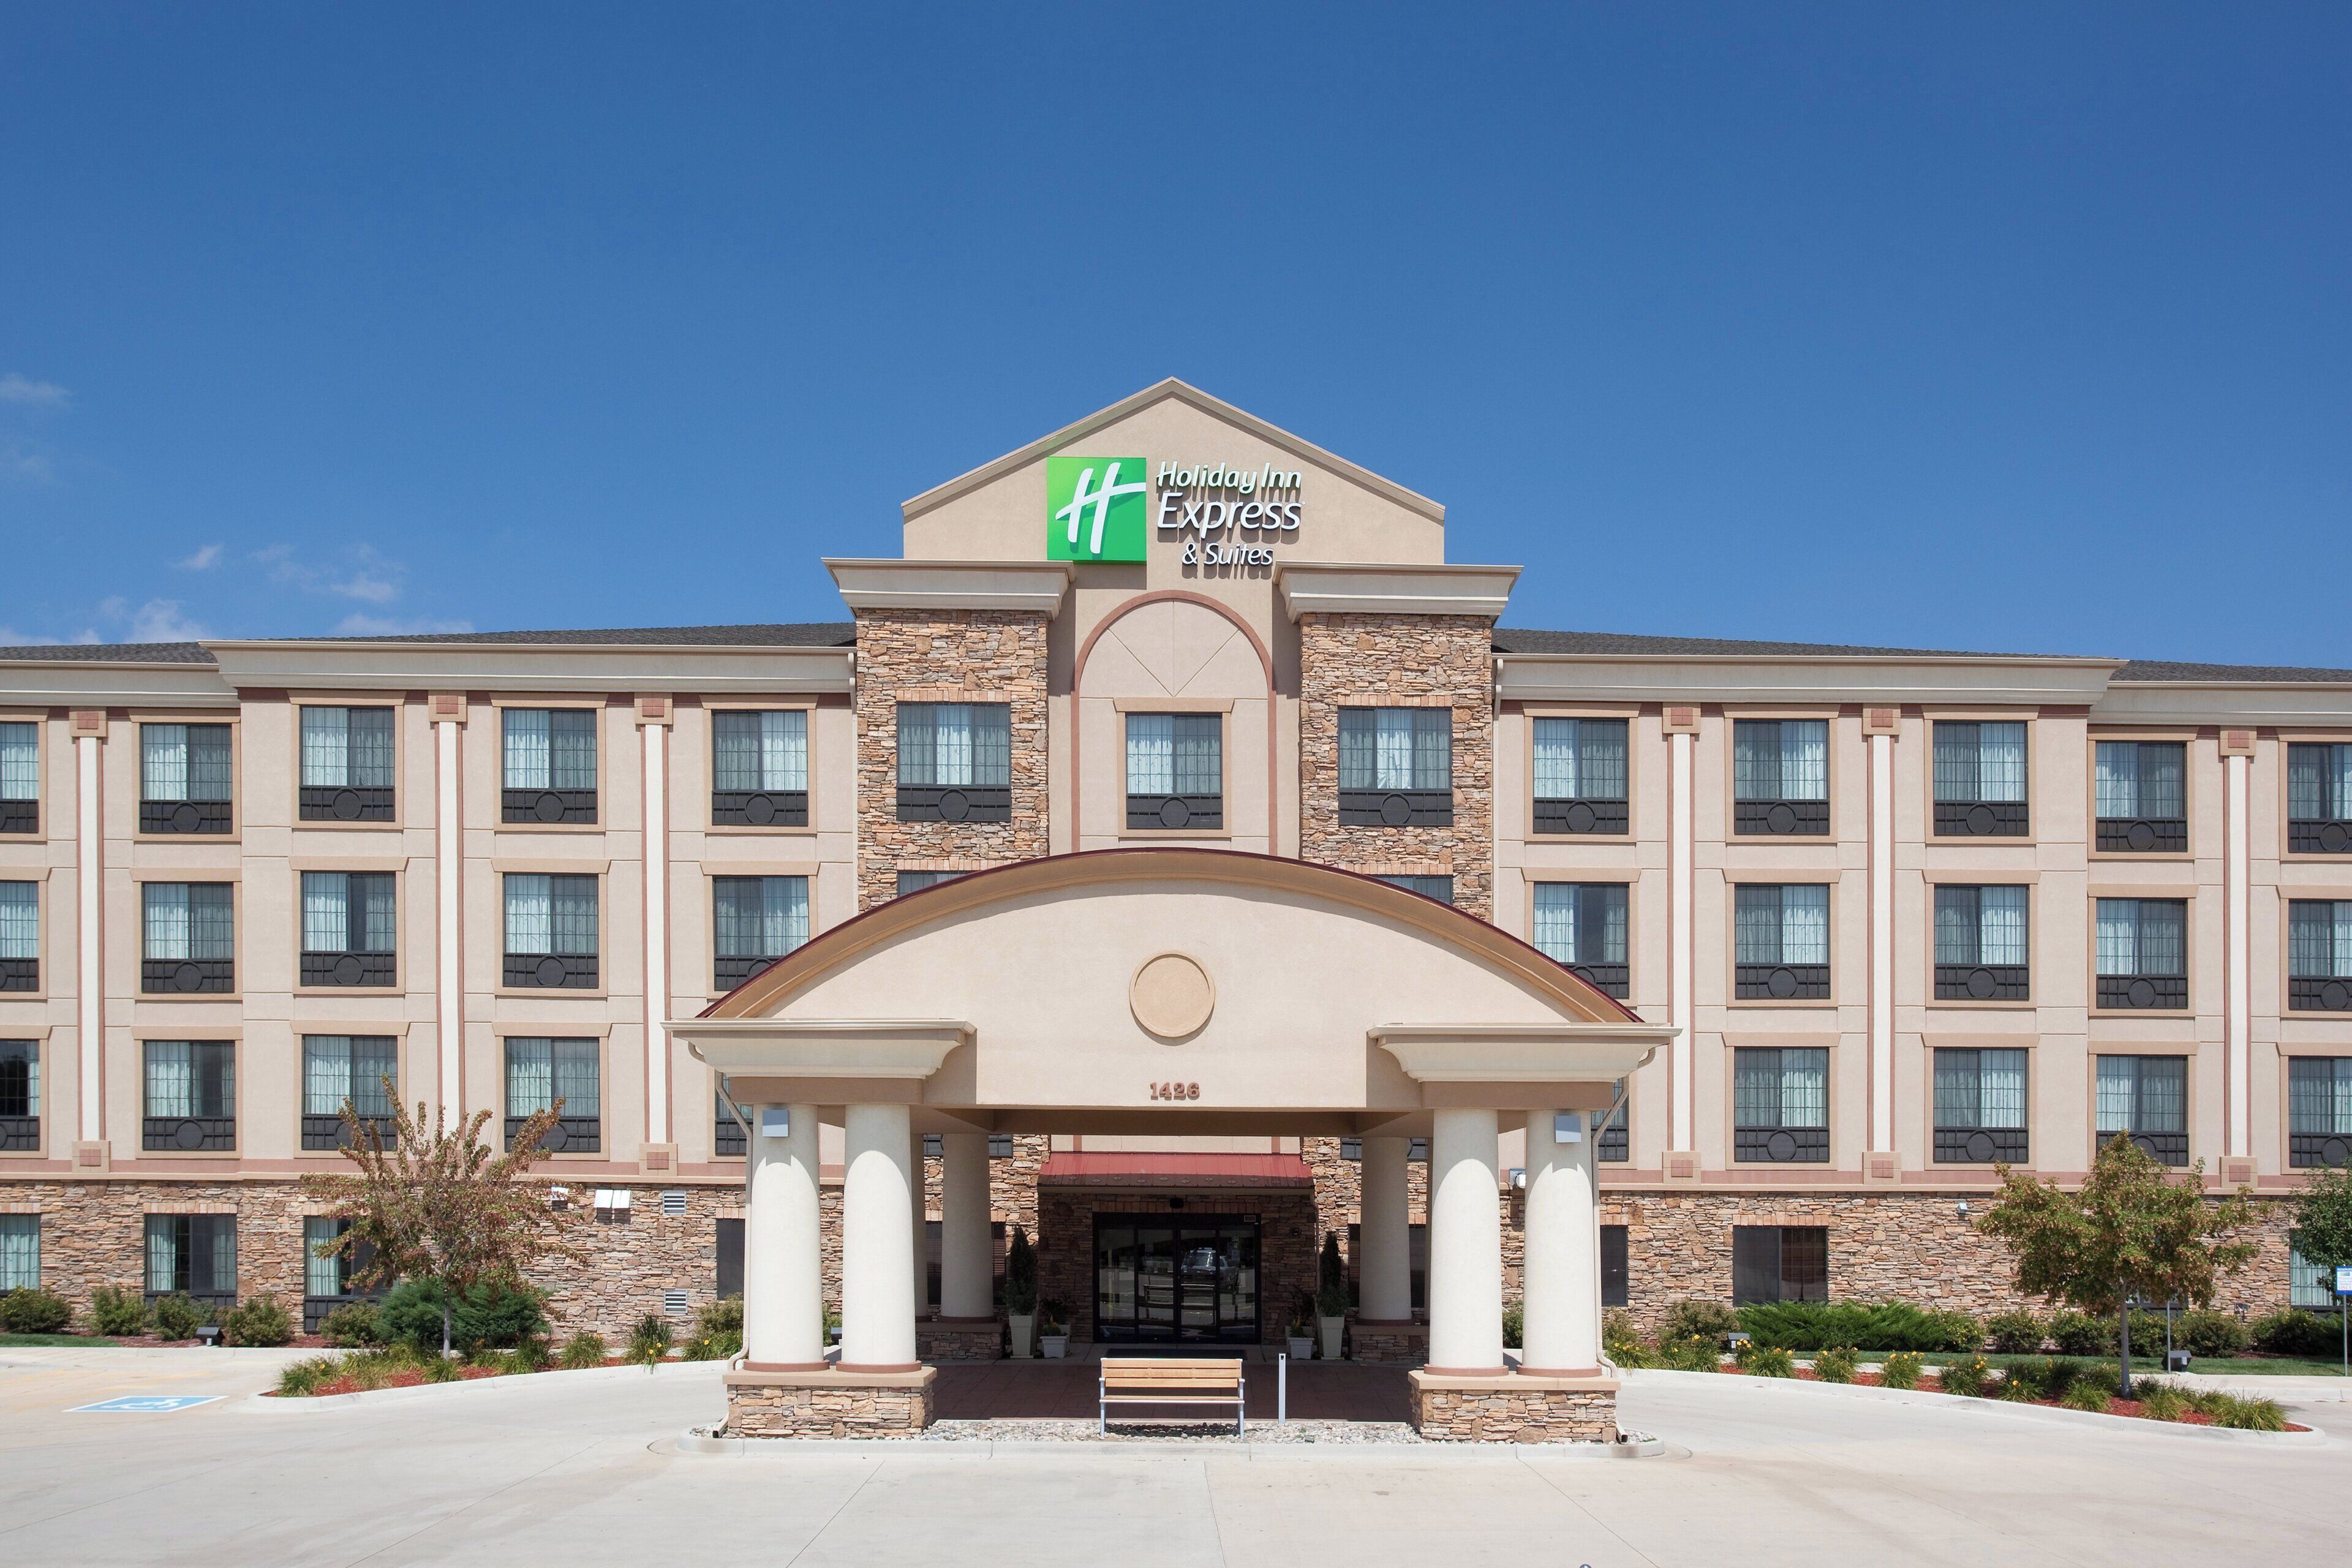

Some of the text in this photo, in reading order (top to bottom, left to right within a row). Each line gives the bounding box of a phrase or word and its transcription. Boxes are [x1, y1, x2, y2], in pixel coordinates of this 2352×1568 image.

[1156, 460, 1302, 494] Holiday Inn
[1157, 490, 1302, 539] Express
[1182, 541, 1275, 565] & Suites
[1150, 1082, 1200, 1101] 1426
